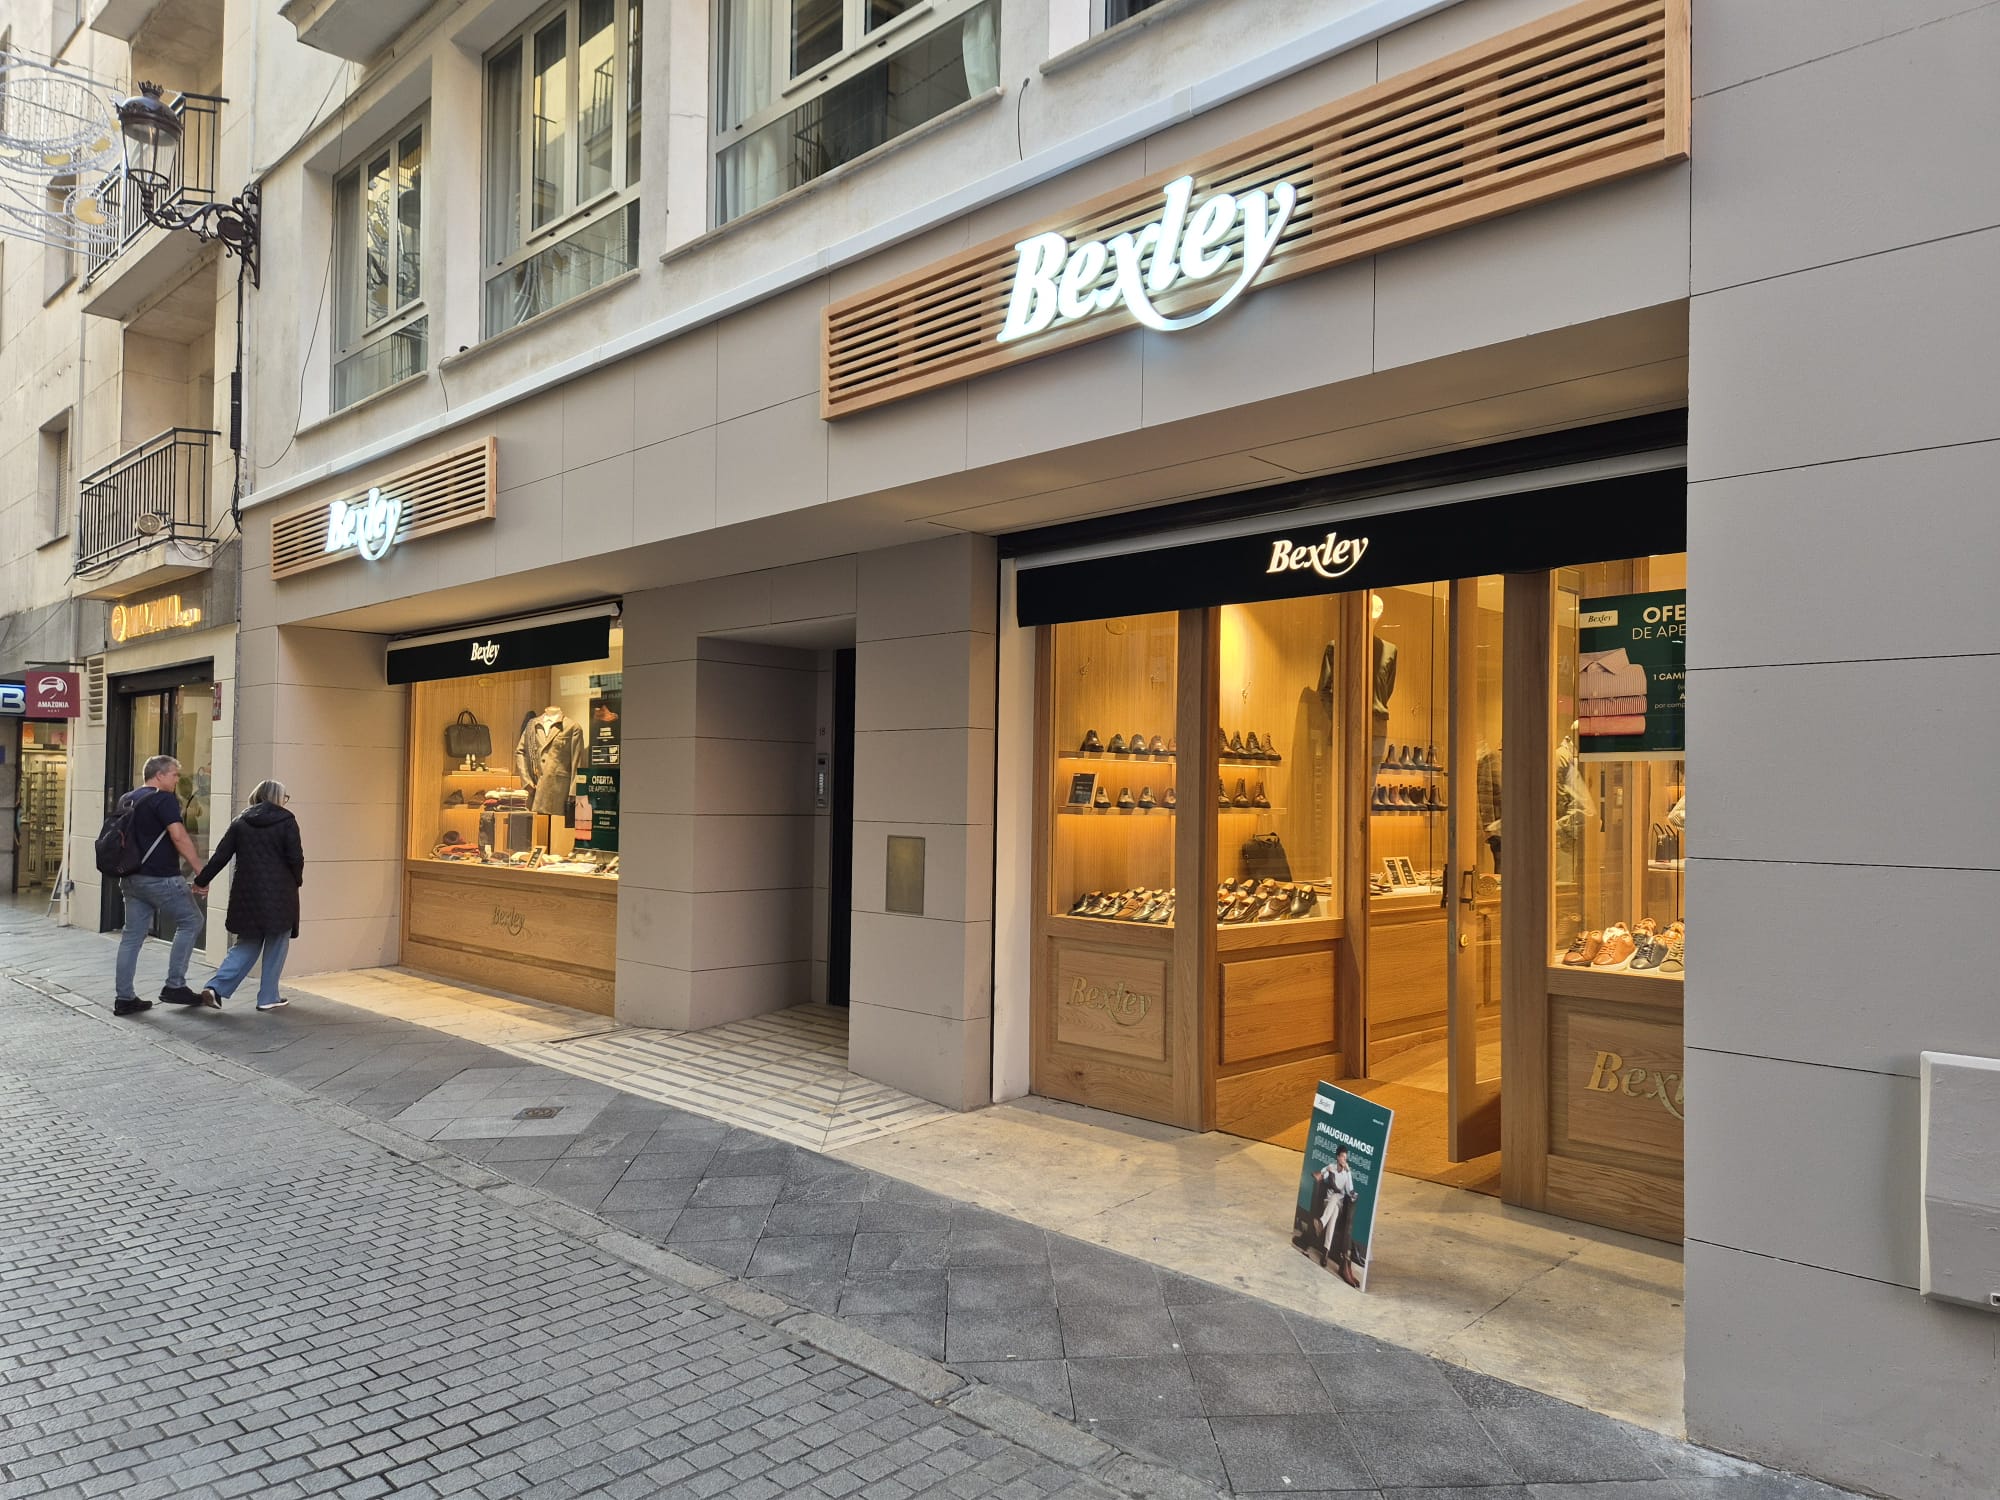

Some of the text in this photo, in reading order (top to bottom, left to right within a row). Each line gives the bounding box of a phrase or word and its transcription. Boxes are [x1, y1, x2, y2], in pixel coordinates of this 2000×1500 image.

[996, 175, 1297, 343] Bexley
[325, 487, 402, 561] Bexley
[1266, 532, 1369, 578] Bexley
[470, 640, 500, 665] Bexley
[1632, 626, 1653, 640] DE
[1066, 975, 1152, 1027] Bexley
